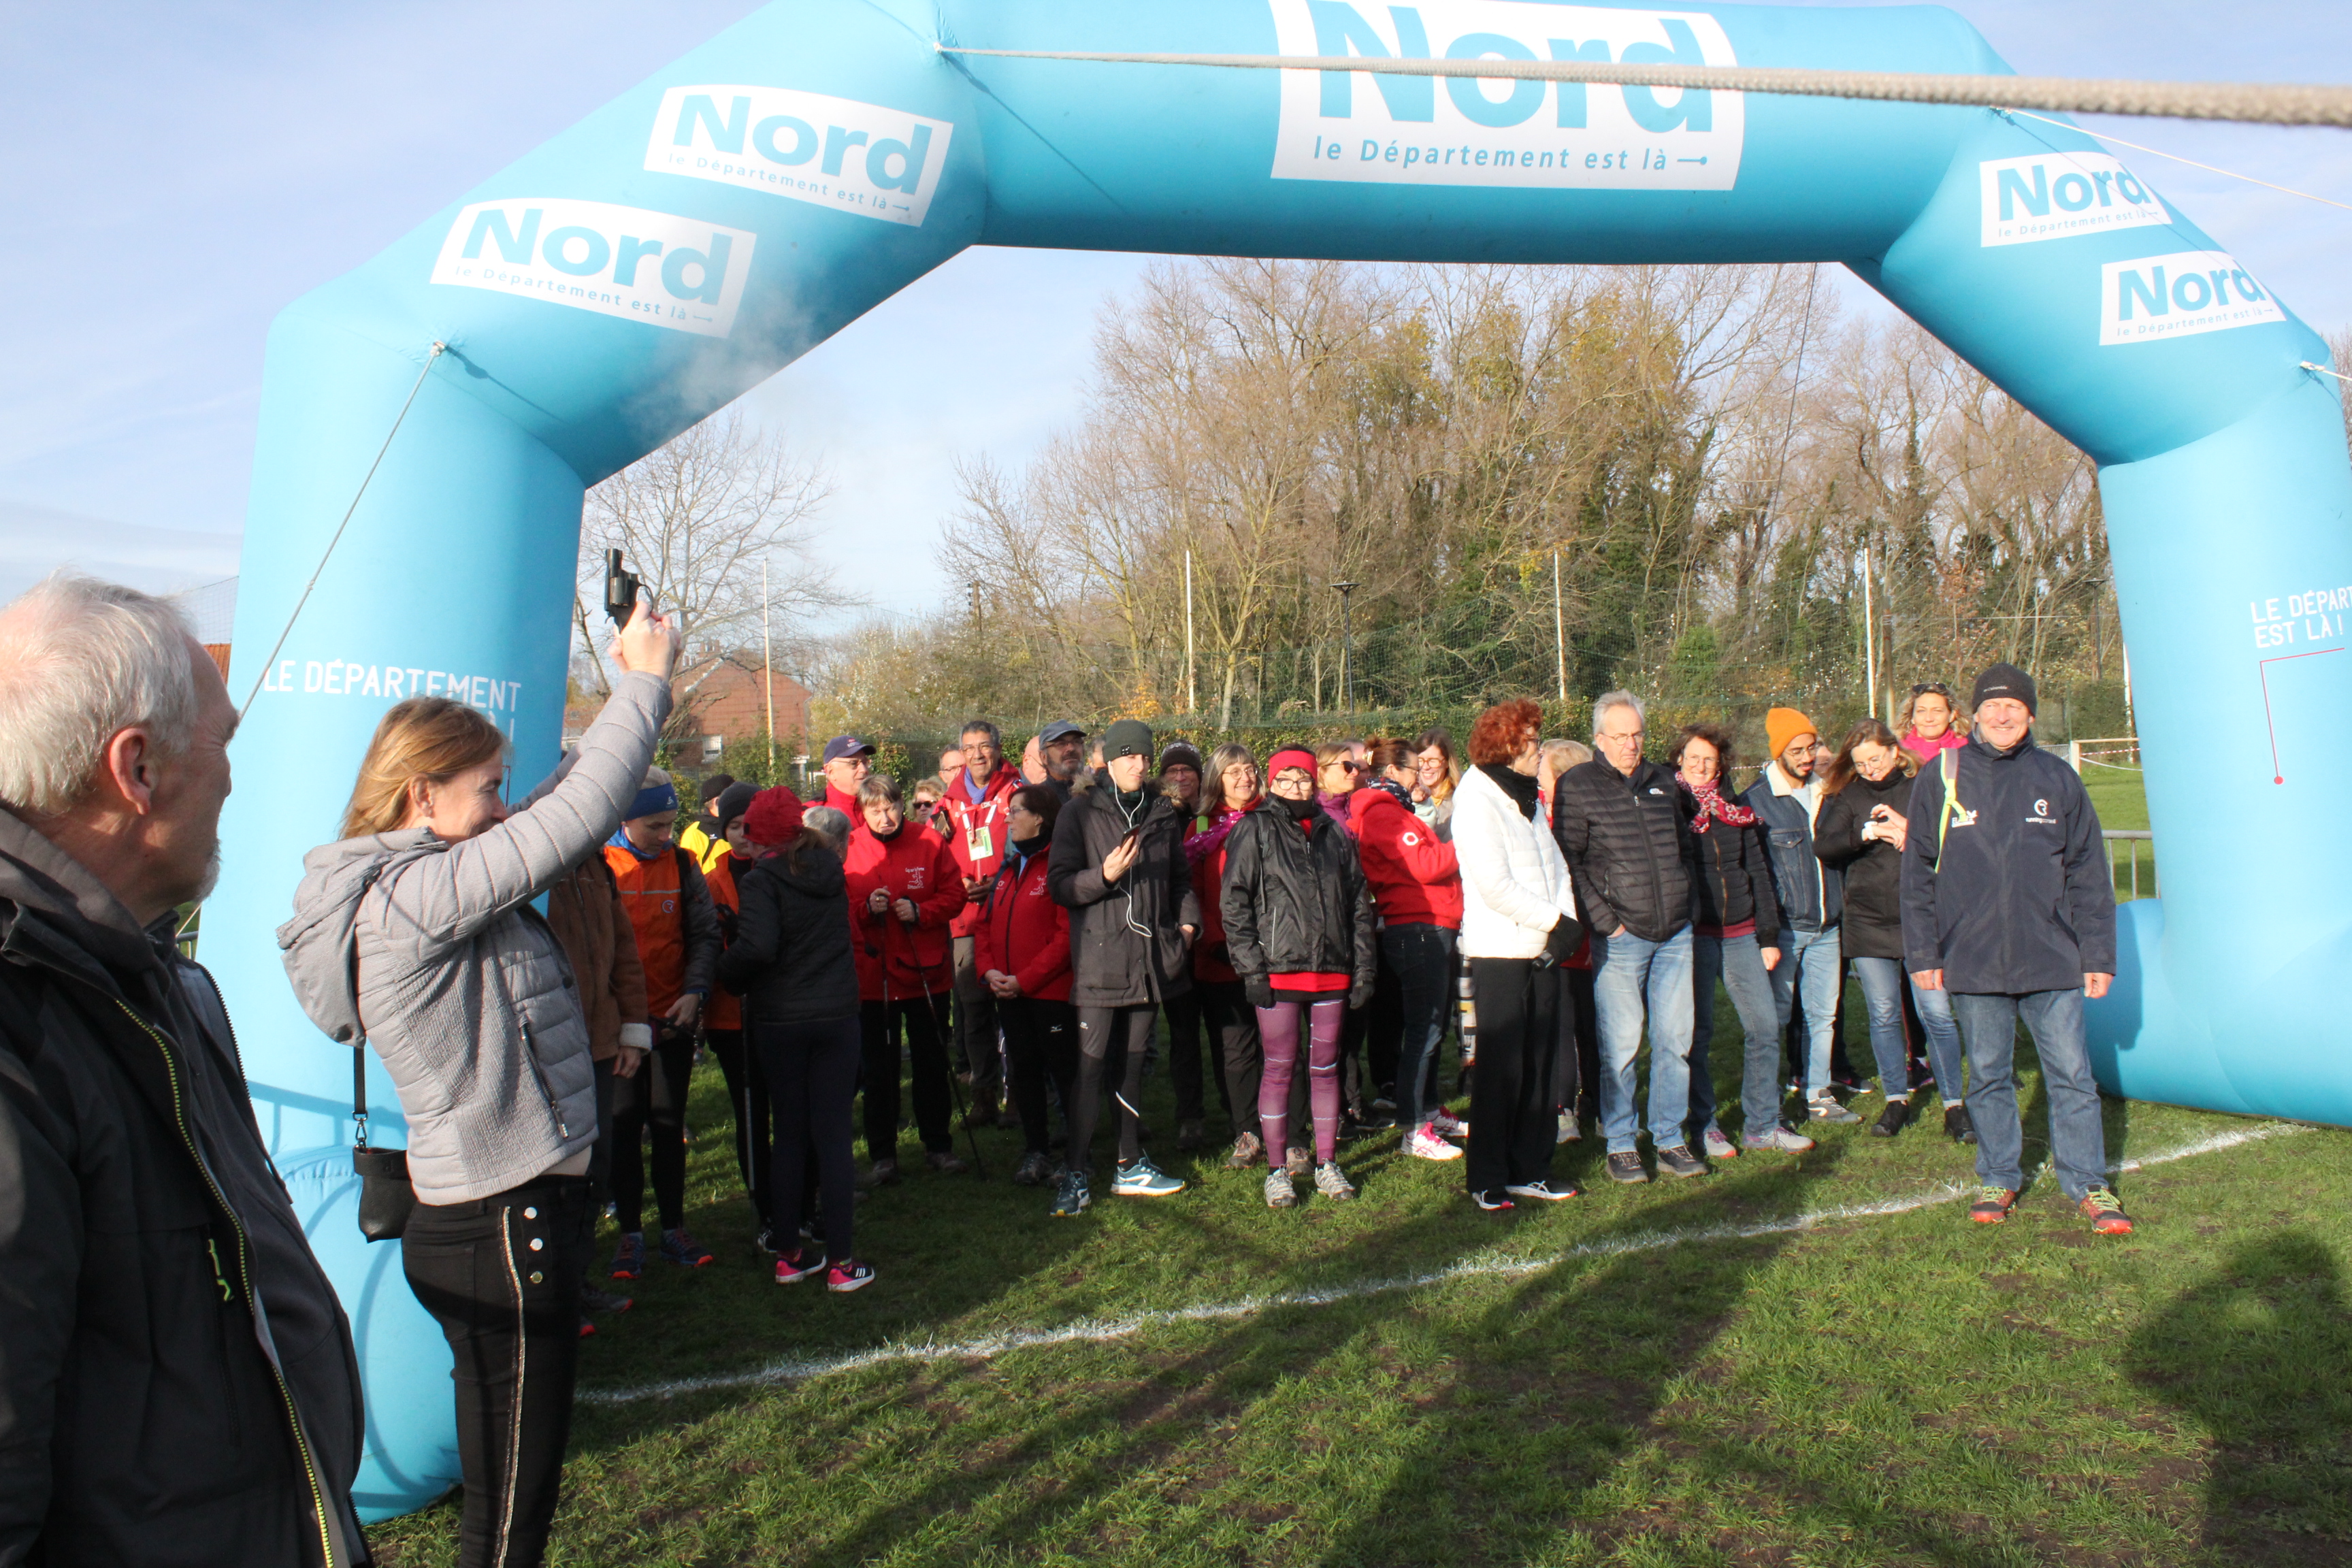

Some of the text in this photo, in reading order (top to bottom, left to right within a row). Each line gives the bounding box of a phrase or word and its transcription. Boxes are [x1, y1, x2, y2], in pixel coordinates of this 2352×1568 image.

[1305, 0, 1712, 133] Nord
[673, 95, 932, 195] Nord
[1313, 136, 1666, 170] le Département est là
[669, 154, 887, 209] le Département est là
[1997, 165, 2152, 221] Nord
[1999, 210, 2146, 237] le Département est là
[461, 208, 733, 306] Nord
[456, 266, 686, 320] le Département est là
[2119, 259, 2266, 321] Nord
[2117, 308, 2262, 336] le Département est là
[2250, 598, 2282, 623] LE
[2255, 614, 2343, 648] EST LÀ !
[264, 658, 521, 712] LE DÉPARTEMENT
